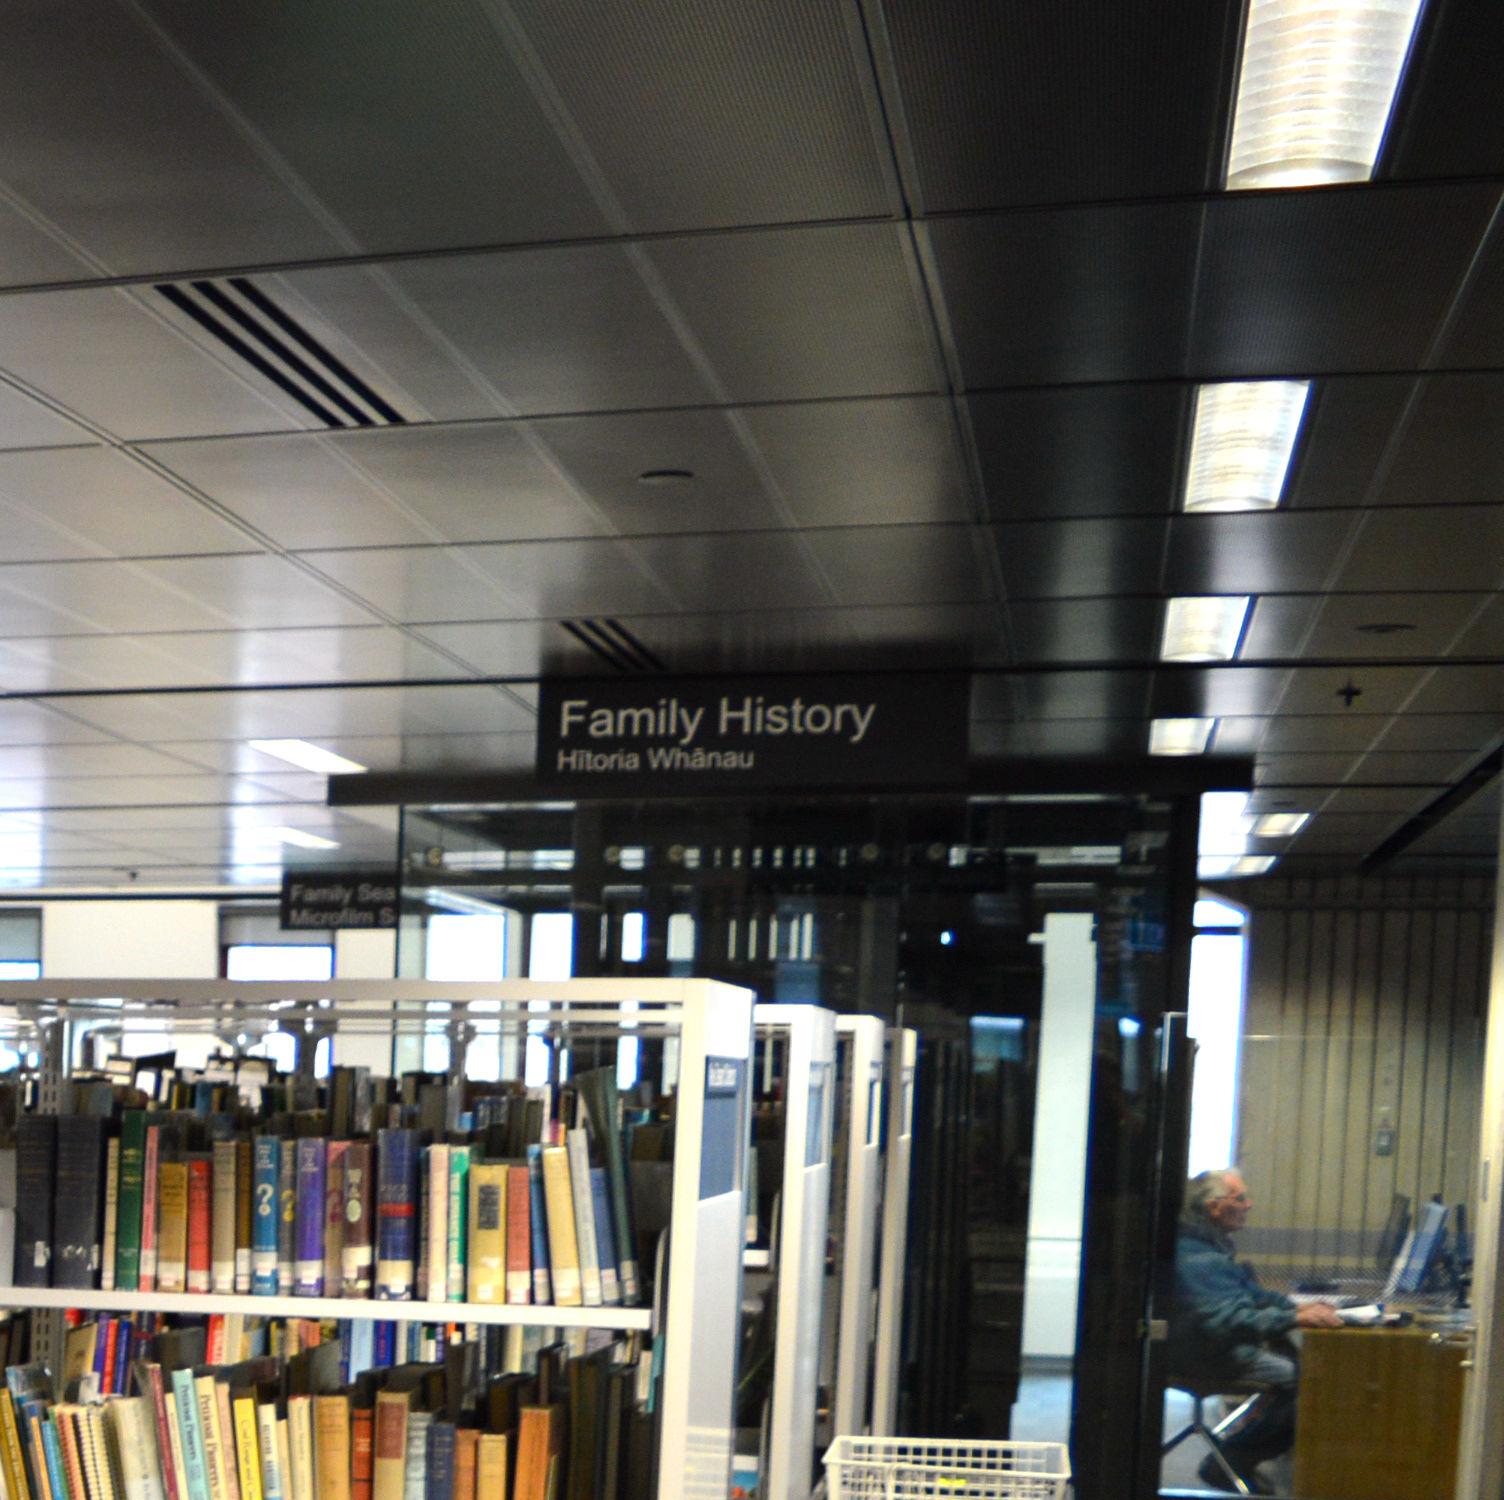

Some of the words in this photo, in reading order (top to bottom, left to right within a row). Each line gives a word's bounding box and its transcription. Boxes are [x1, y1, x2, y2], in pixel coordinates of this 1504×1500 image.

[560, 698, 705, 745] Family
[719, 696, 876, 743] History
[647, 747, 755, 770] Whānau
[290, 883, 353, 905] Family
